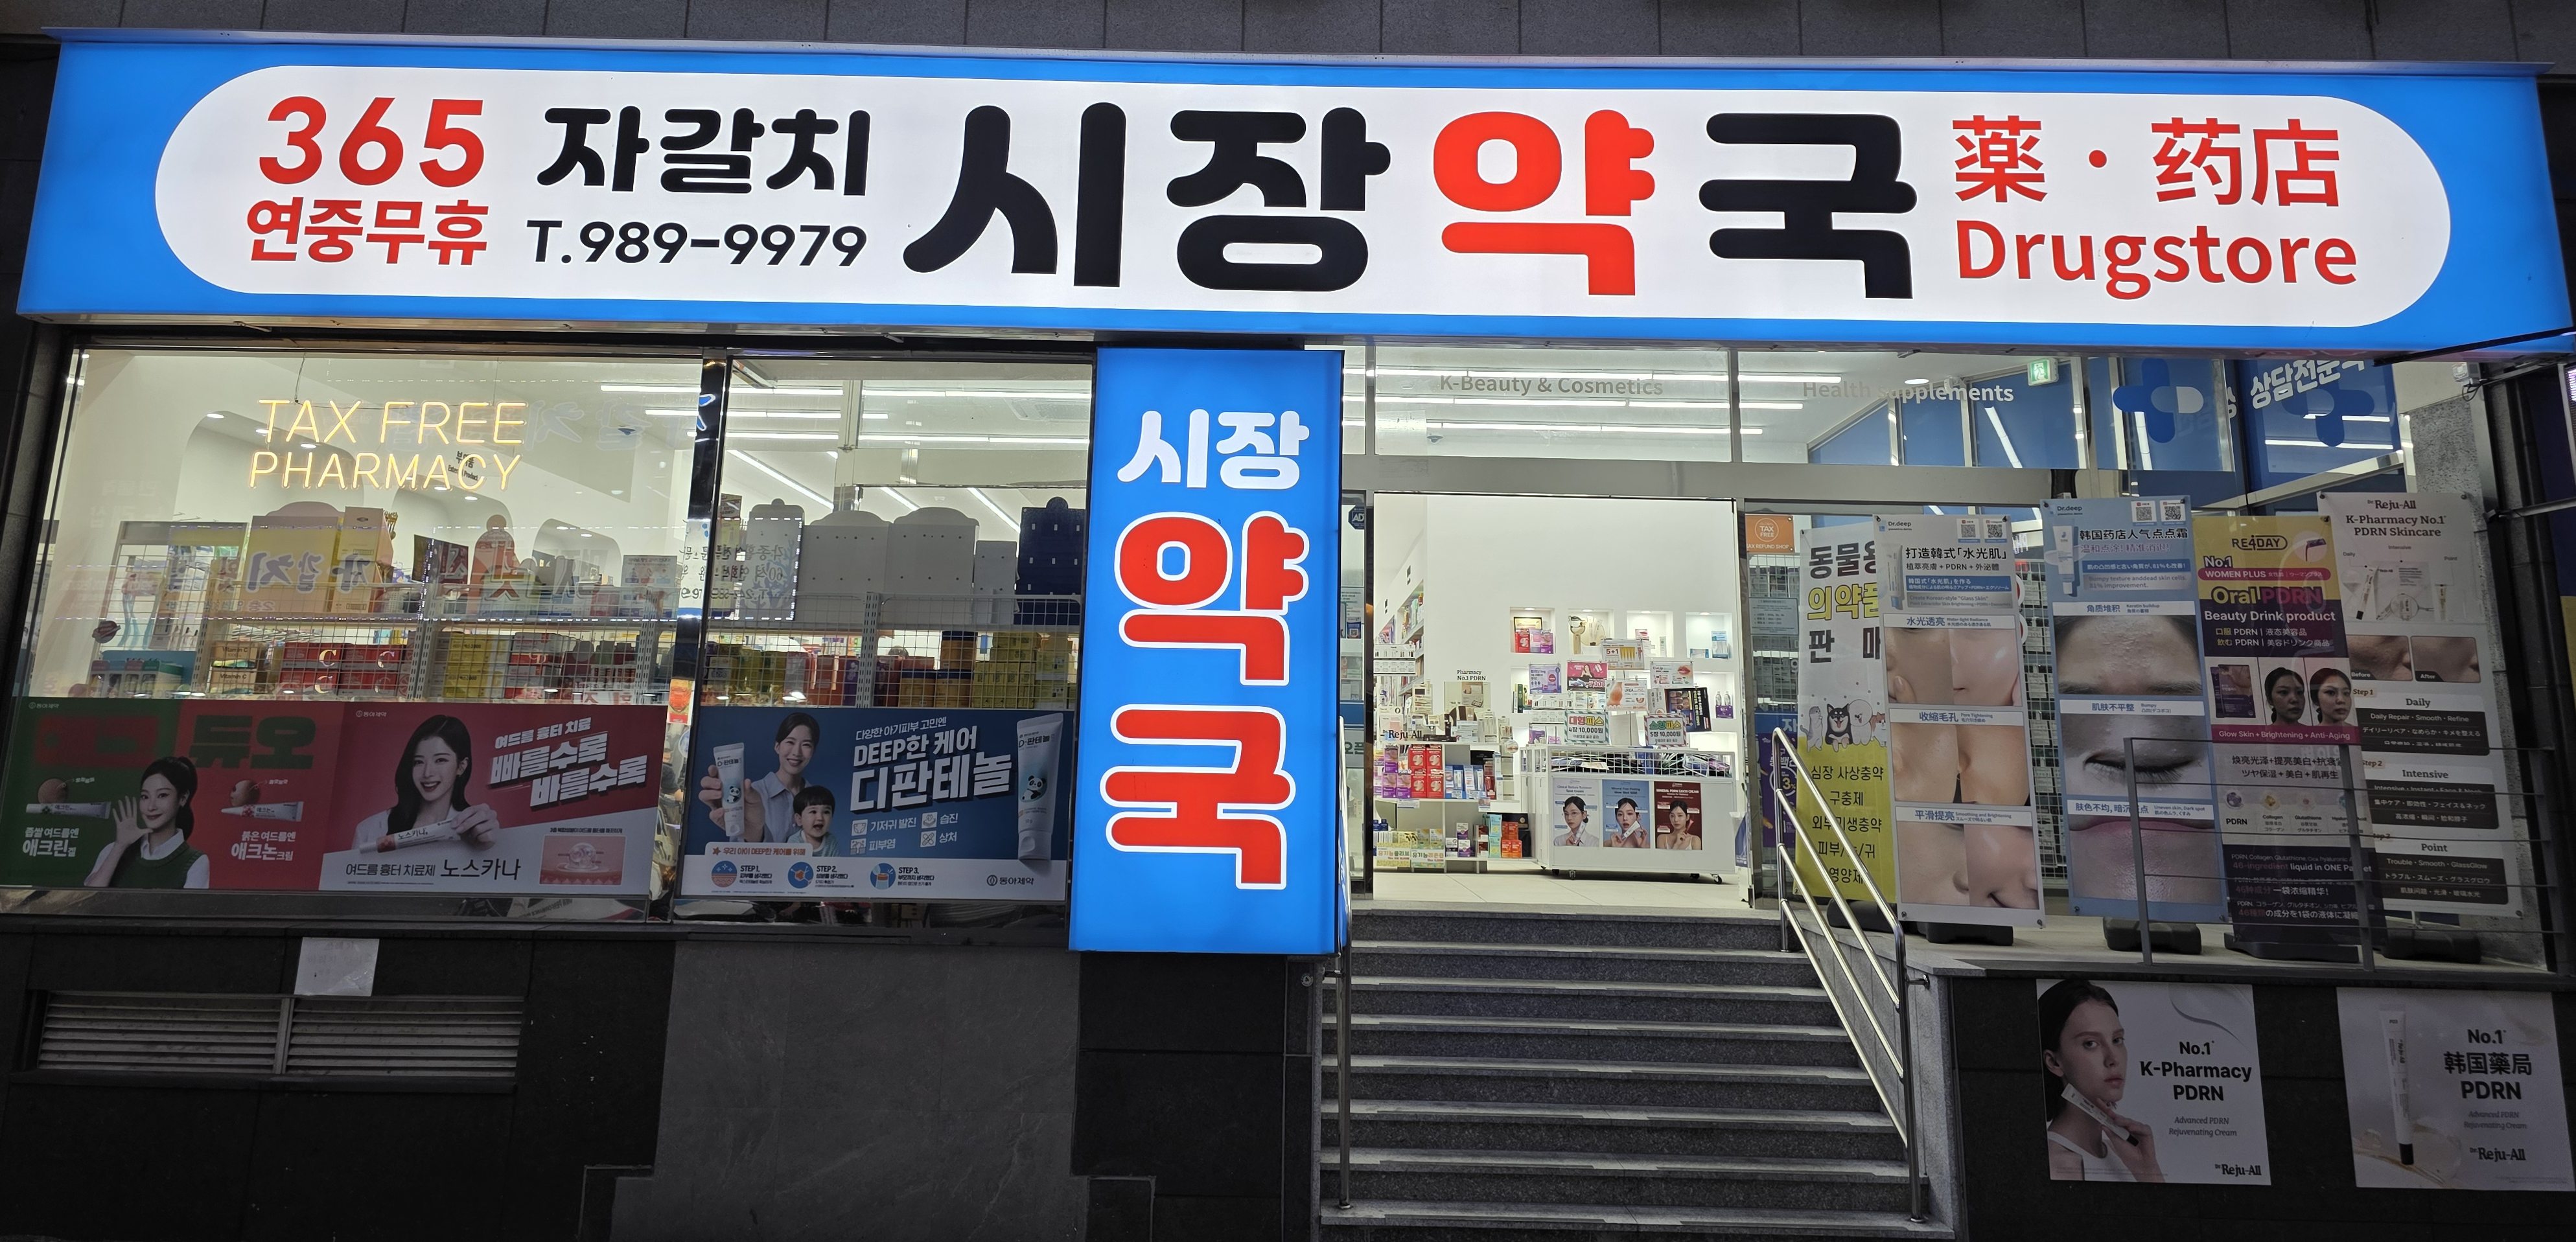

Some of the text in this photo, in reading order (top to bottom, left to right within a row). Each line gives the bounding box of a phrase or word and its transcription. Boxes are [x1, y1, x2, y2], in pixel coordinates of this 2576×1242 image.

[259, 96, 485, 186] 365
[536, 106, 870, 196] 자갈치
[246, 198, 489, 266] 연중무휴
[526, 220, 867, 268] T.989-9979
[1956, 219, 2357, 300] Drugstore
[1440, 374, 1532, 397] K-Beauty
[1558, 377, 1664, 396] Cosmetics
[1803, 382, 1872, 398] Health
[2251, 360, 2365, 409] 상담전문
[259, 400, 527, 445] TAX FREE
[1117, 409, 1309, 490] 시장
[249, 451, 522, 490] PHARMACY
[2375, 500, 2416, 510] Reju-All
[2346, 515, 2418, 526] K-Pharmacy
[2354, 527, 2441, 537] PDRN Skincare
[2204, 556, 2233, 568] No.1
[2212, 586, 2323, 604] Oral PDRN
[1907, 617, 1945, 626] 水光透亮
[2205, 611, 2336, 623] Beauty Drink product
[2353, 689, 2369, 697] Step
[2092, 702, 2135, 711] 肌肤不平整
[2406, 698, 2431, 708] Daily
[494, 717, 591, 750] 여드름 흉터 치료
[855, 717, 947, 741] 다양한 아기피부 고민엔
[1388, 730, 1422, 739] Reju-All
[2261, 731, 2303, 740] Brightening
[2310, 731, 2350, 741] Anti-Aging
[189, 715, 316, 770] 듀오
[853, 725, 977, 768] DEEP한 케어
[489, 733, 608, 785] 빠를수록
[1811, 765, 1884, 781] 심장 사상충약
[2402, 770, 2449, 779] Intensive
[530, 755, 647, 807] 바를수록
[850, 752, 1012, 812] 디판테놀
[1830, 791, 1863, 806] 구충제
[870, 815, 917, 832] 기저귀 발진
[940, 812, 958, 825] 습진
[44, 827, 79, 839] 여드름엔
[261, 831, 296, 842] 여드름엔
[939, 831, 957, 844] 상처
[737, 847, 750, 855] 아이
[773, 847, 791, 856] 케어를
[869, 838, 896, 851] 피부염
[1818, 842, 1875, 858] 피부//귀
[2421, 844, 2448, 853] Point
[345, 858, 521, 882] 여드름 흉터 치료제 노스카나
[2290, 863, 2313, 872] liquid
[999, 877, 1034, 886] 동아제약
[2467, 1029, 2504, 1044] No.1
[2179, 1041, 2212, 1055] No.1
[2444, 1052, 2532, 1075] 韩国藥局
[2140, 1061, 2252, 1082] K-Pharmacy
[2174, 1085, 2223, 1101] PDRN
[2461, 1081, 2522, 1099] PDRN
[2174, 1116, 2207, 1125] Advanced
[2464, 1121, 2505, 1130] Rejuvenating
[2169, 1128, 2213, 1138] Rejuvenating
[2478, 1147, 2526, 1162] Reju-All
[2222, 1164, 2262, 1177] Reju-All
